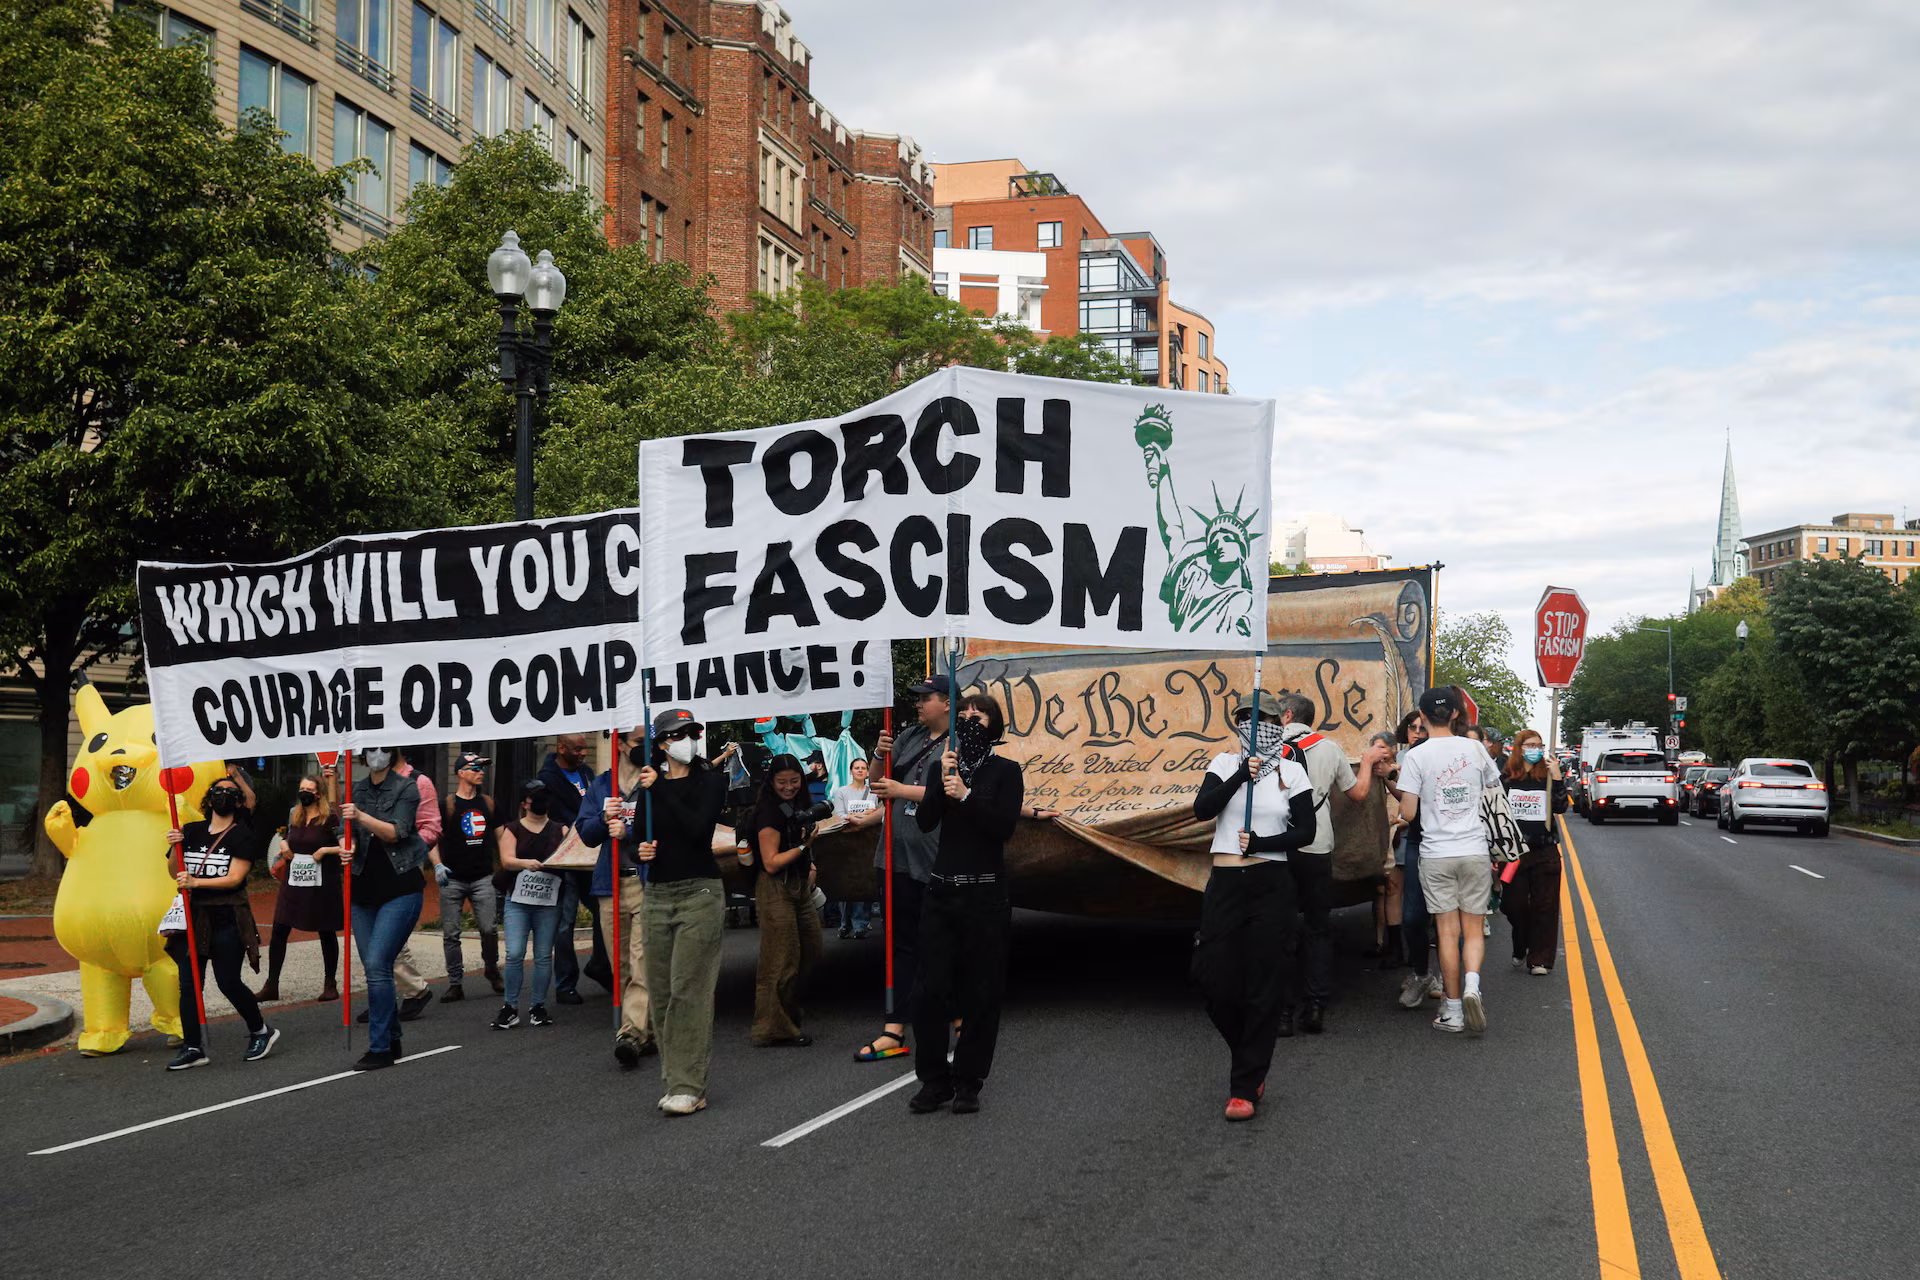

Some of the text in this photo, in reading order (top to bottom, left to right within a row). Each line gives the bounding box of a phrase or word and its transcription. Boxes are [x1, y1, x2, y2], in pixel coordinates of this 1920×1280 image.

[682, 396, 1072, 528] TORCH
[155, 564, 317, 646] WHICH
[323, 547, 458, 626] WILL
[468, 528, 590, 615] YOU
[681, 512, 1148, 646] FASCISM
[1538, 636, 1581, 658] FASCISM
[1543, 610, 1580, 638] STOP
[192, 666, 385, 746] COURAGE
[399, 661, 474, 730] OR
[1078, 671, 1168, 741] the
[1165, 658, 1373, 742] Pele
[1030, 753, 1075, 774] the
[1083, 748, 1164, 774] United
[1066, 780, 1091, 798] to
[1088, 778, 1143, 803] form
[1149, 784, 1161, 794] a
[1161, 783, 1201, 795] mor
[206, 864, 228, 876] DC
